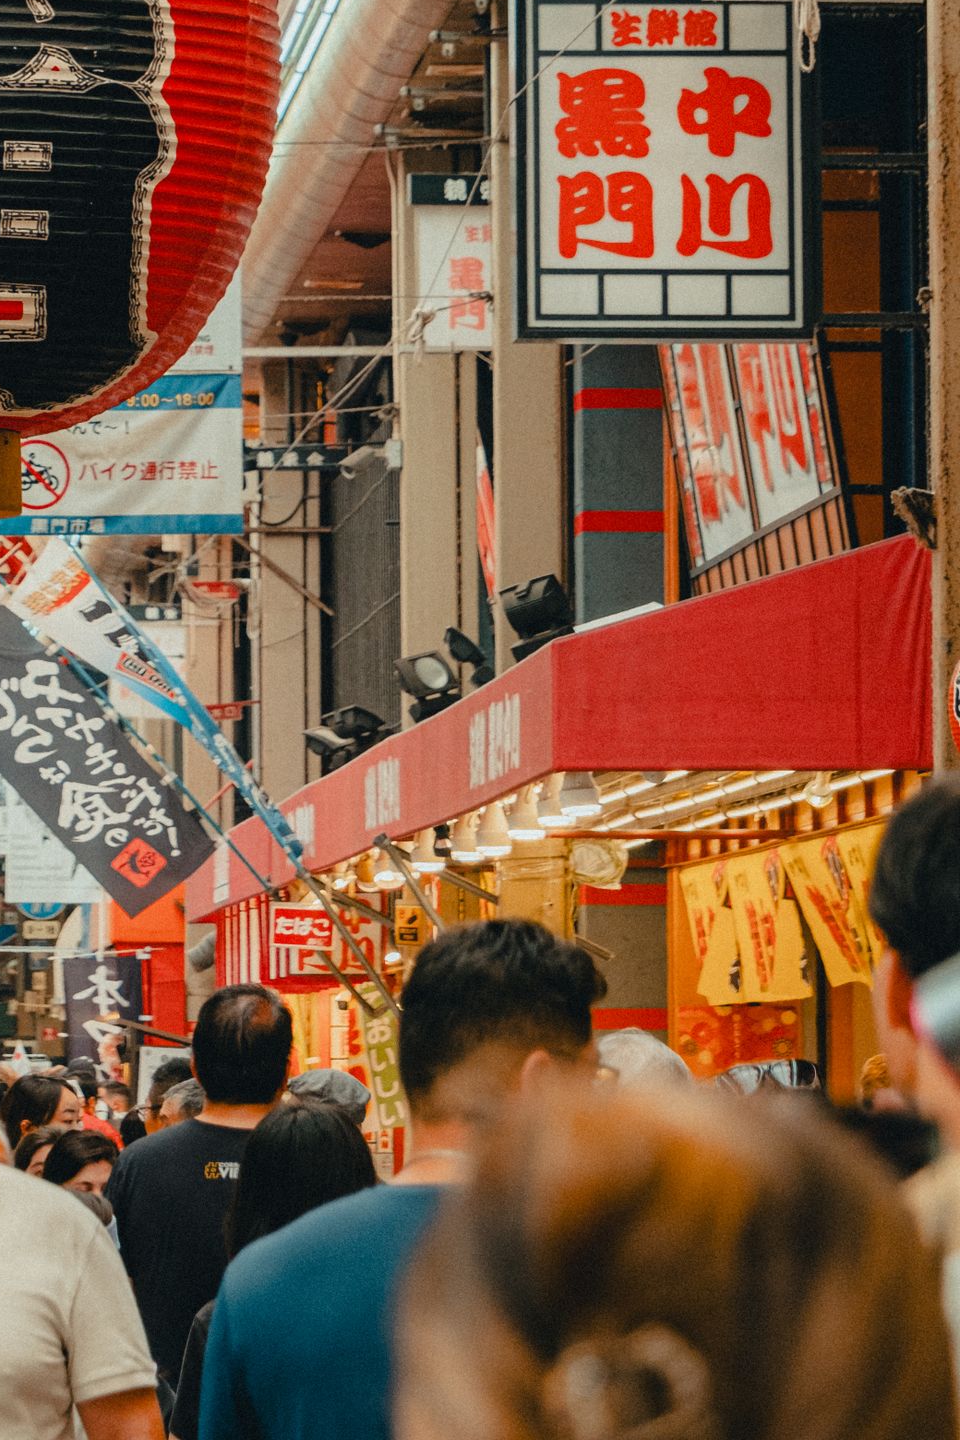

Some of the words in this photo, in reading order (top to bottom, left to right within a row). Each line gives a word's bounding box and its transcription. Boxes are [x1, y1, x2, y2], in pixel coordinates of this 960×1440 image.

[611, 9, 717, 47] 生鮮館
[554, 68, 654, 259] 黒門
[78, 461, 219, 481] バイク通行禁止
[275, 916, 330, 937] たばこ
